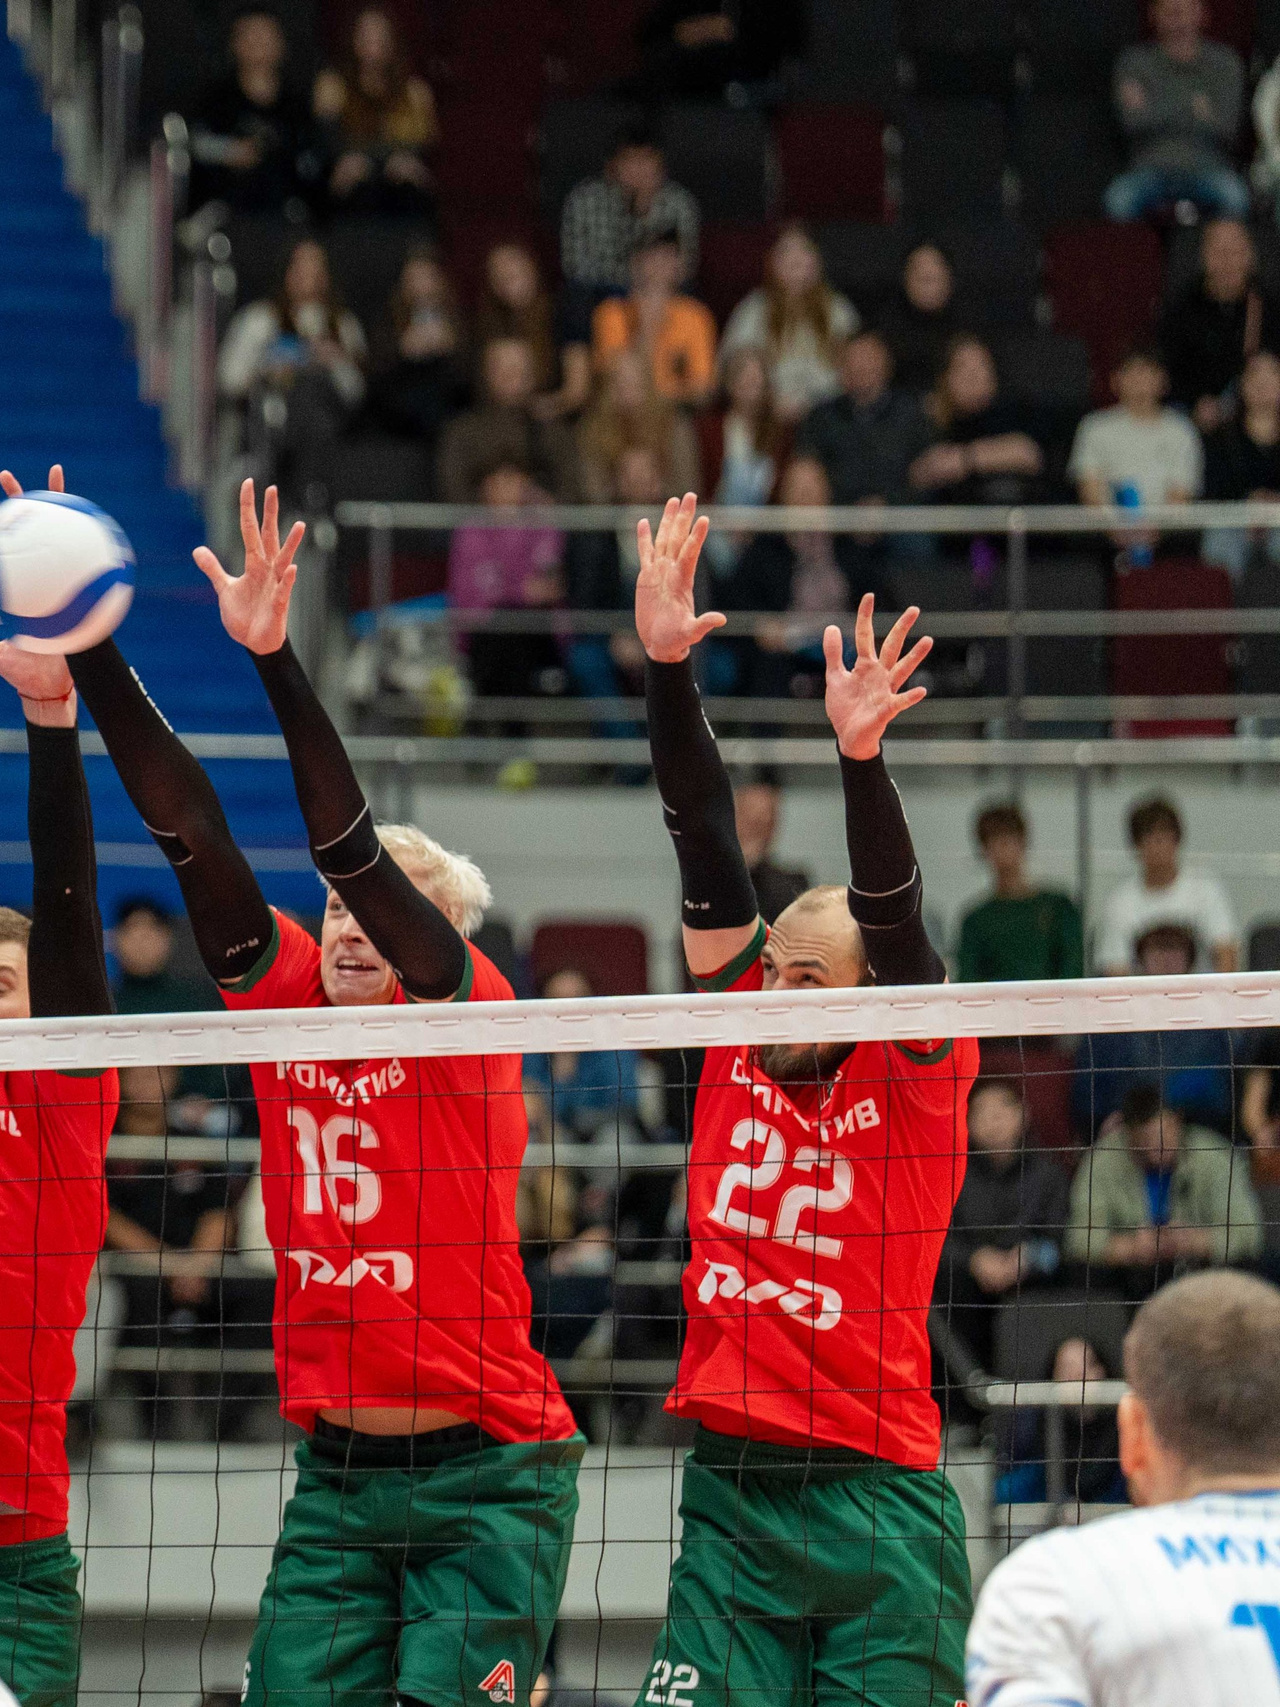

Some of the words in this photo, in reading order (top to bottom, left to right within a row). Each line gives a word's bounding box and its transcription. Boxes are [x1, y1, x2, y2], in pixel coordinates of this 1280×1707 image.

[286, 1105, 382, 1226] 16
[707, 1117, 854, 1261] 22
[644, 1658, 700, 1707] 22
